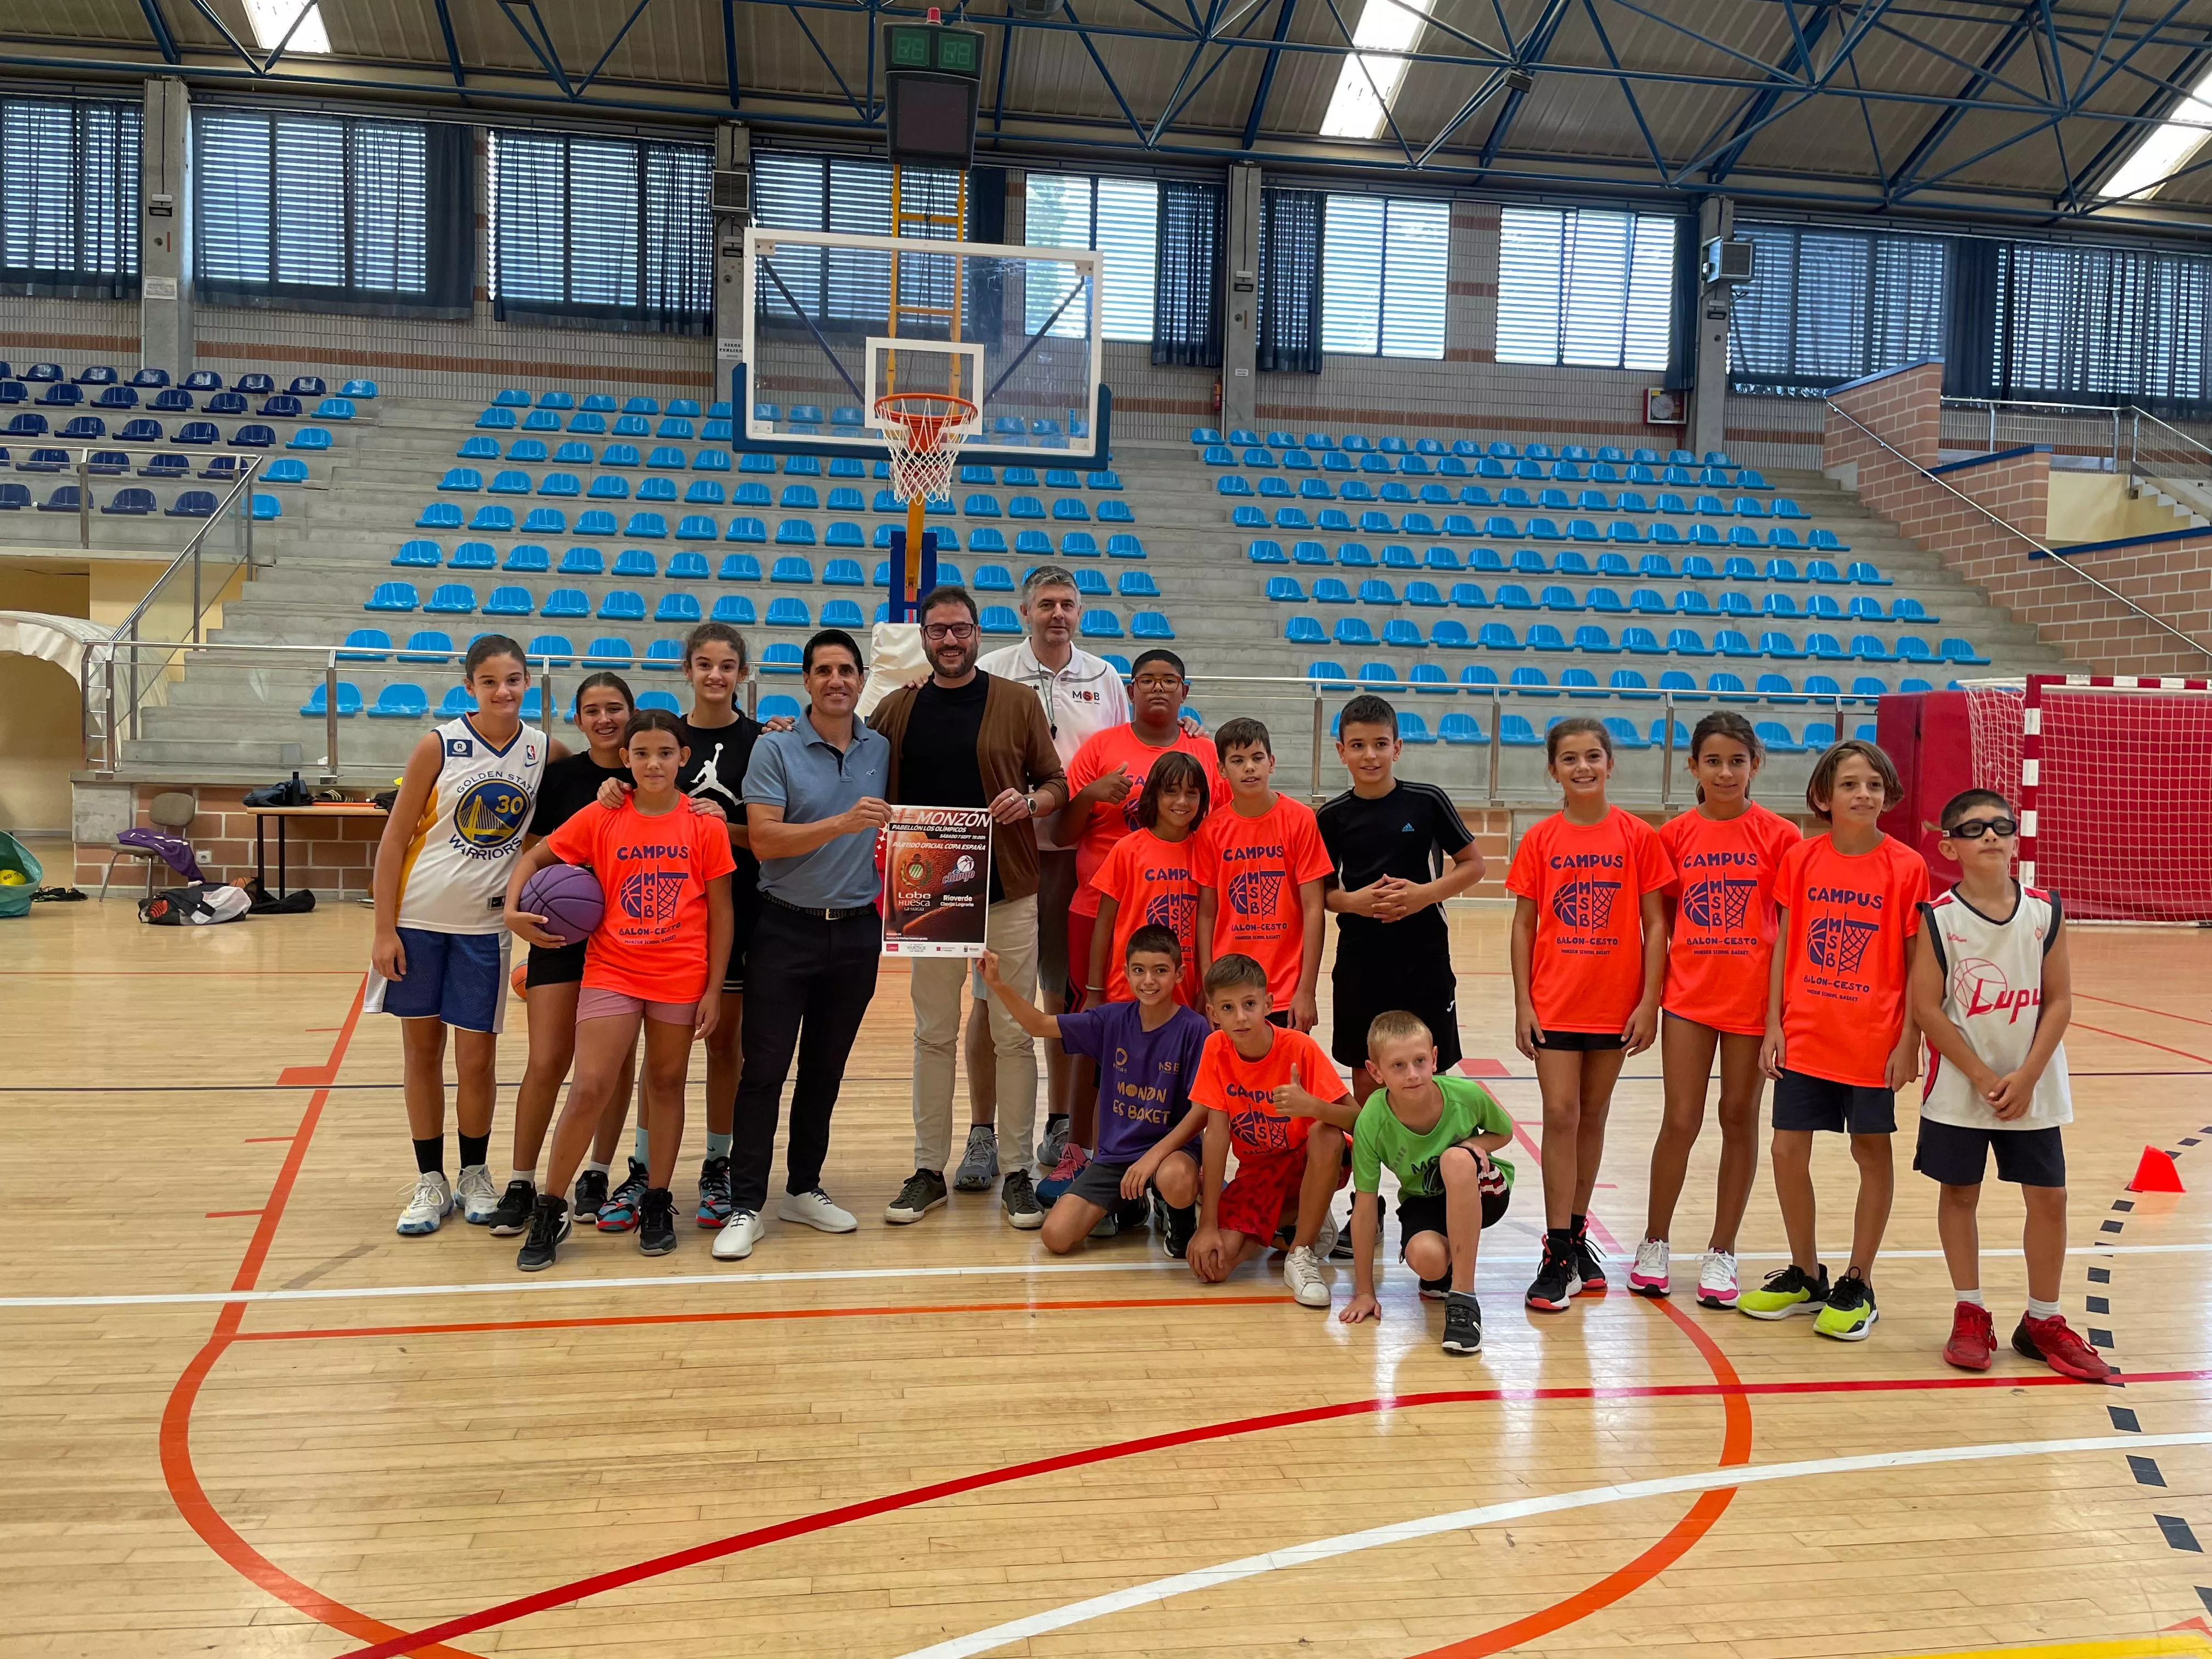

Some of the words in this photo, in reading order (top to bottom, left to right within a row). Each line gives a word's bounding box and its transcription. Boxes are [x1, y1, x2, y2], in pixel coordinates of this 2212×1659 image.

[1072, 691, 1100, 701] MSB
[457, 771, 503, 793] GOLDEN
[507, 774, 536, 798] STATE
[495, 795, 524, 815] 30
[916, 811, 991, 827] MONZÓN
[617, 845, 689, 860] CAMPUS
[1223, 845, 1284, 861] CAMPUS
[1683, 853, 1757, 868] CAMPUS
[1550, 854, 1623, 869] CAMPUS
[1145, 868, 1192, 881] CAMP
[1808, 887, 1883, 909] CAMPUS
[619, 922, 681, 935] BALON-CESTO
[1556, 936, 1618, 945] BALON-CESTO
[1686, 937, 1757, 945] BALON-CESTO
[1803, 975, 1870, 992] BALON-CESTO
[1966, 978, 2040, 1025] Lup
[1227, 1083, 1274, 1104] CAMPU
[1113, 1099, 1125, 1116] ES
